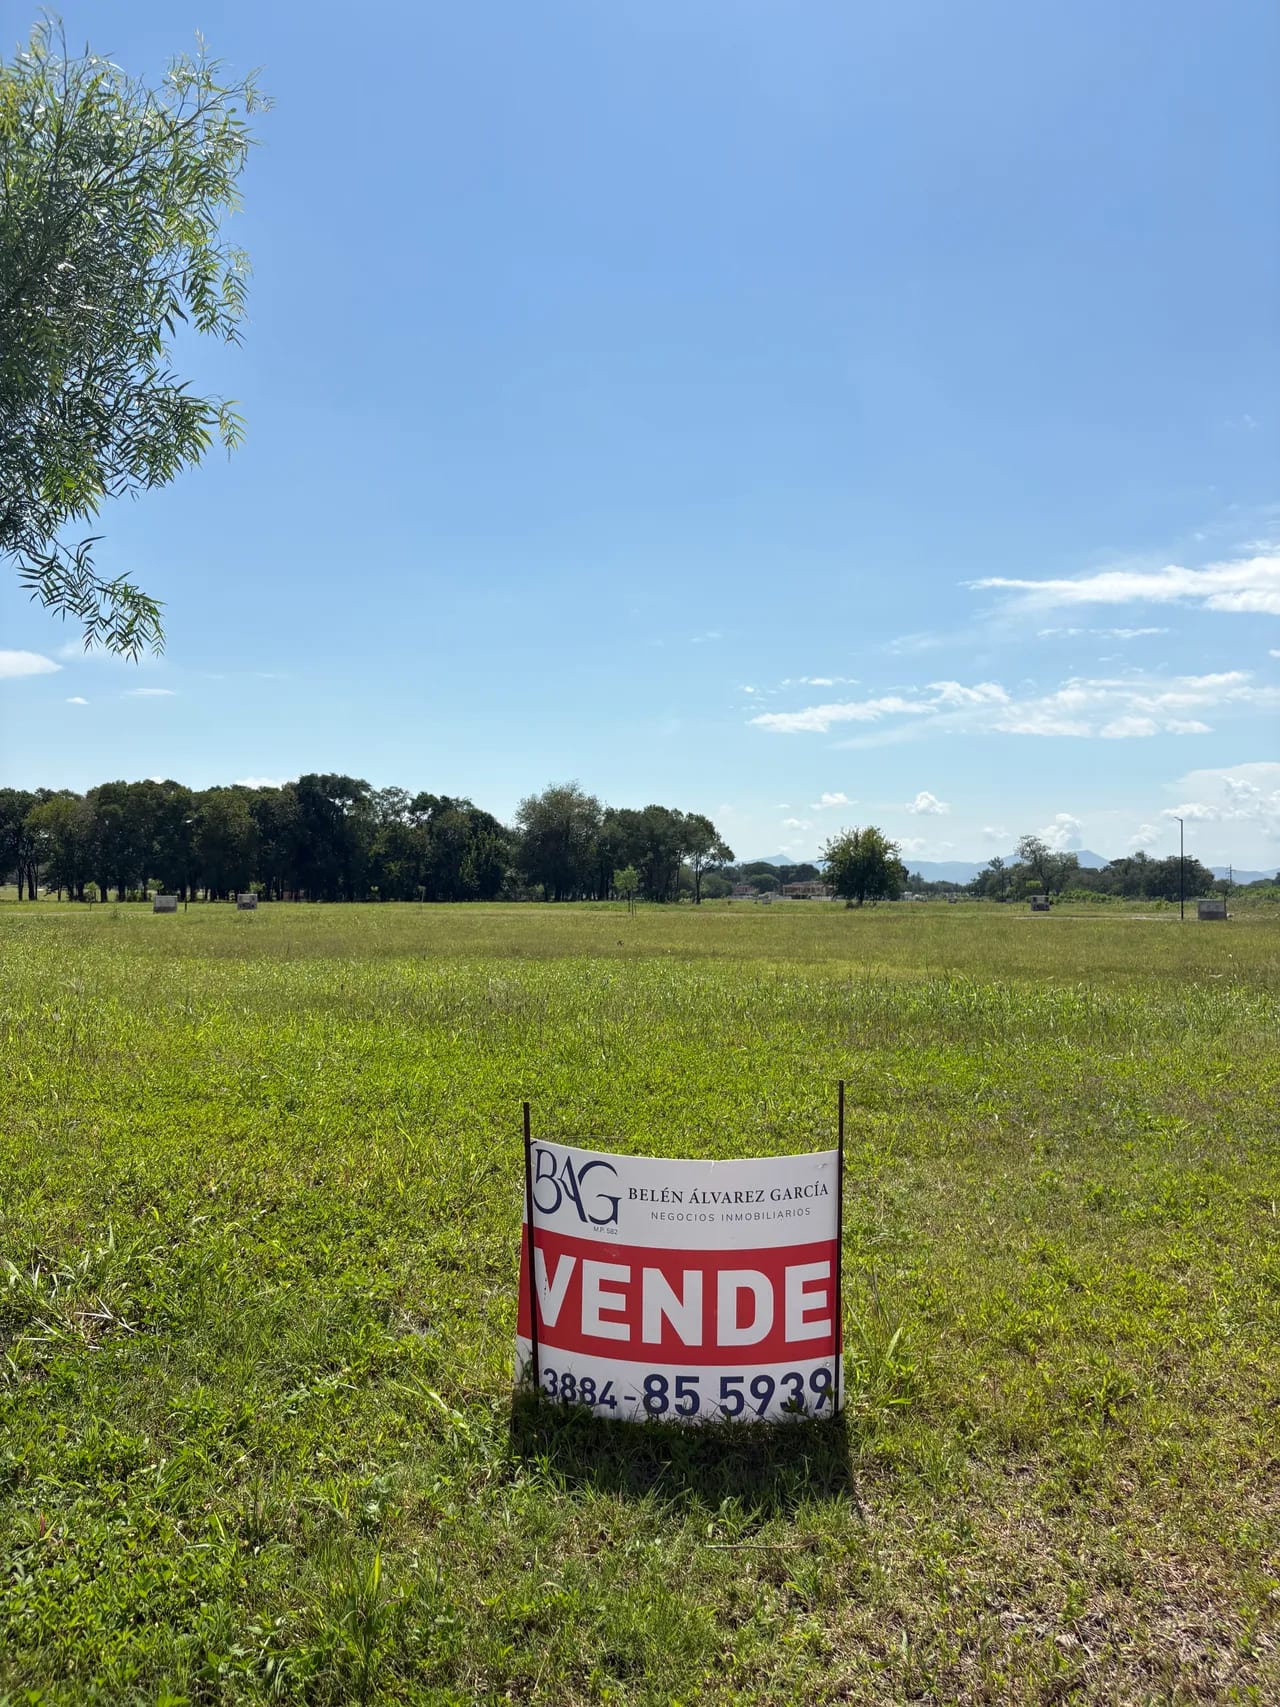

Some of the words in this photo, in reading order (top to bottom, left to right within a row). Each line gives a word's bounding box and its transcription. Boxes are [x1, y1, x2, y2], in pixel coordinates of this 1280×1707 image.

[533, 1149, 622, 1226] BAG
[628, 1187, 683, 1204] BELÉN
[688, 1187, 765, 1205] ÁLVAREZ
[769, 1181, 829, 1201] GARCÍA
[651, 1211, 715, 1222] NEGOCIOS
[721, 1207, 811, 1222] INMOBILIARIOS
[534, 1247, 832, 1347] VENDE
[719, 1367, 833, 1417] 5939
